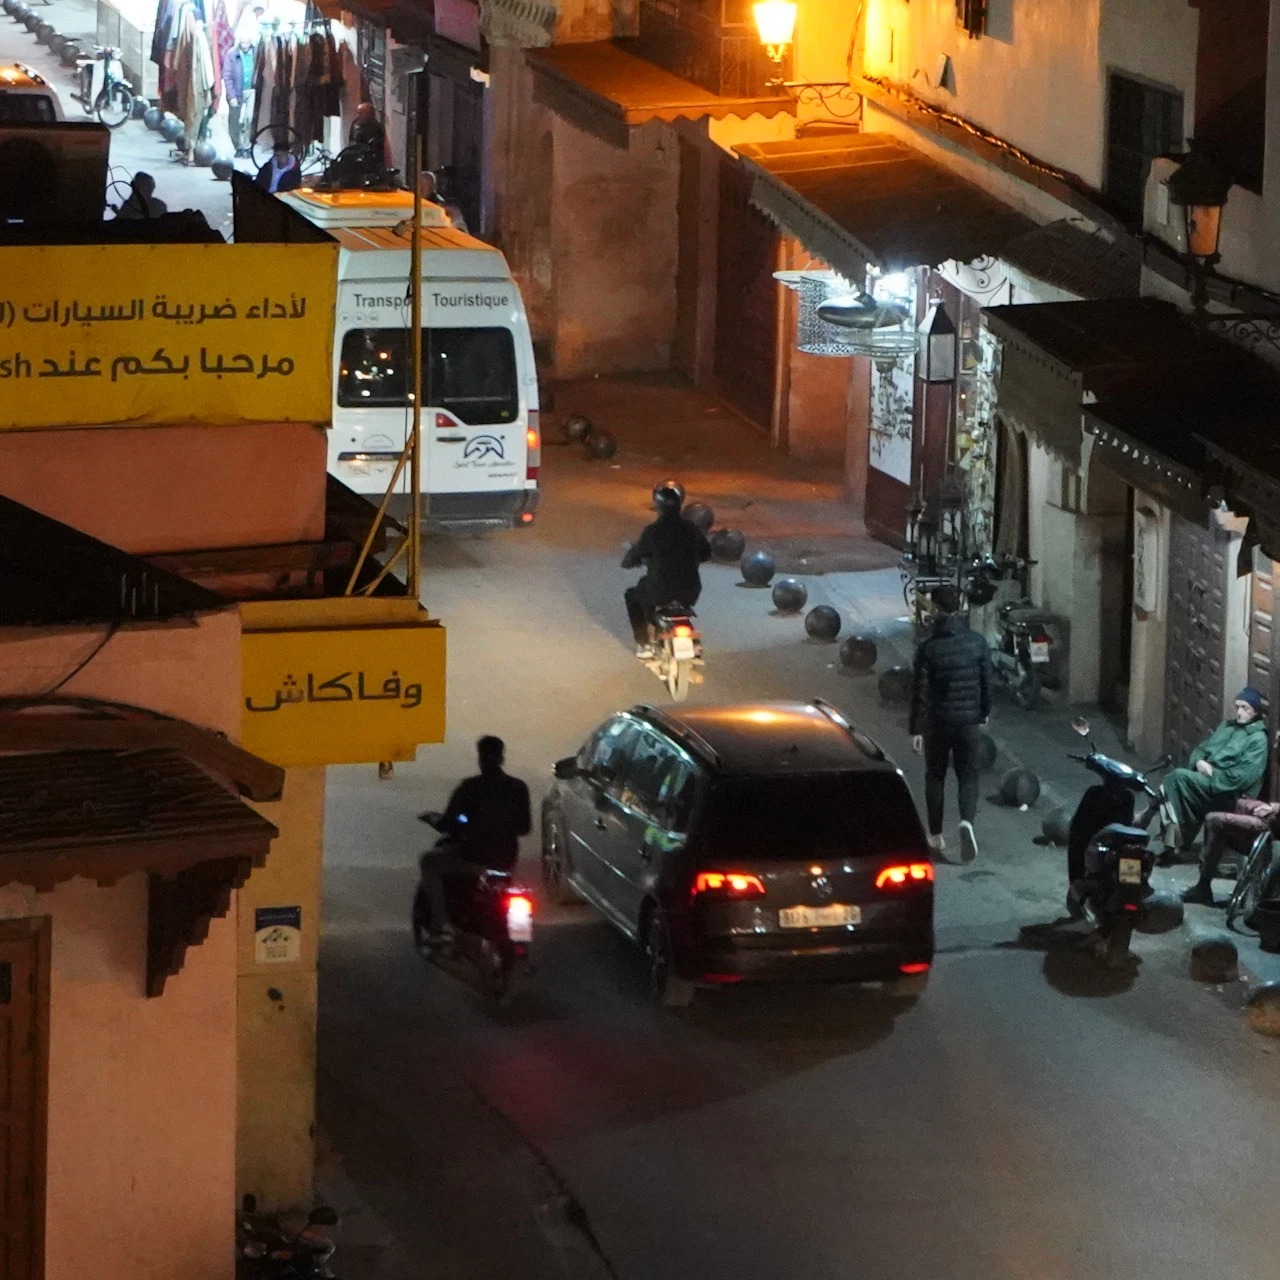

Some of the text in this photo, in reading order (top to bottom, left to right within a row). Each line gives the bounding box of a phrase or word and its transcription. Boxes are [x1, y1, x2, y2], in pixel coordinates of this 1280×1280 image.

[23, 299, 145, 328] السيارات
[151, 294, 237, 325] ضريبة
[246, 292, 307, 320] لأداء
[354, 292, 509, 310] Transpo Touristique
[38, 350, 102, 378] عند
[110, 347, 190, 383] بكم
[199, 346, 295, 380] مرحبا
[245, 670, 422, 712] وفاكاش
